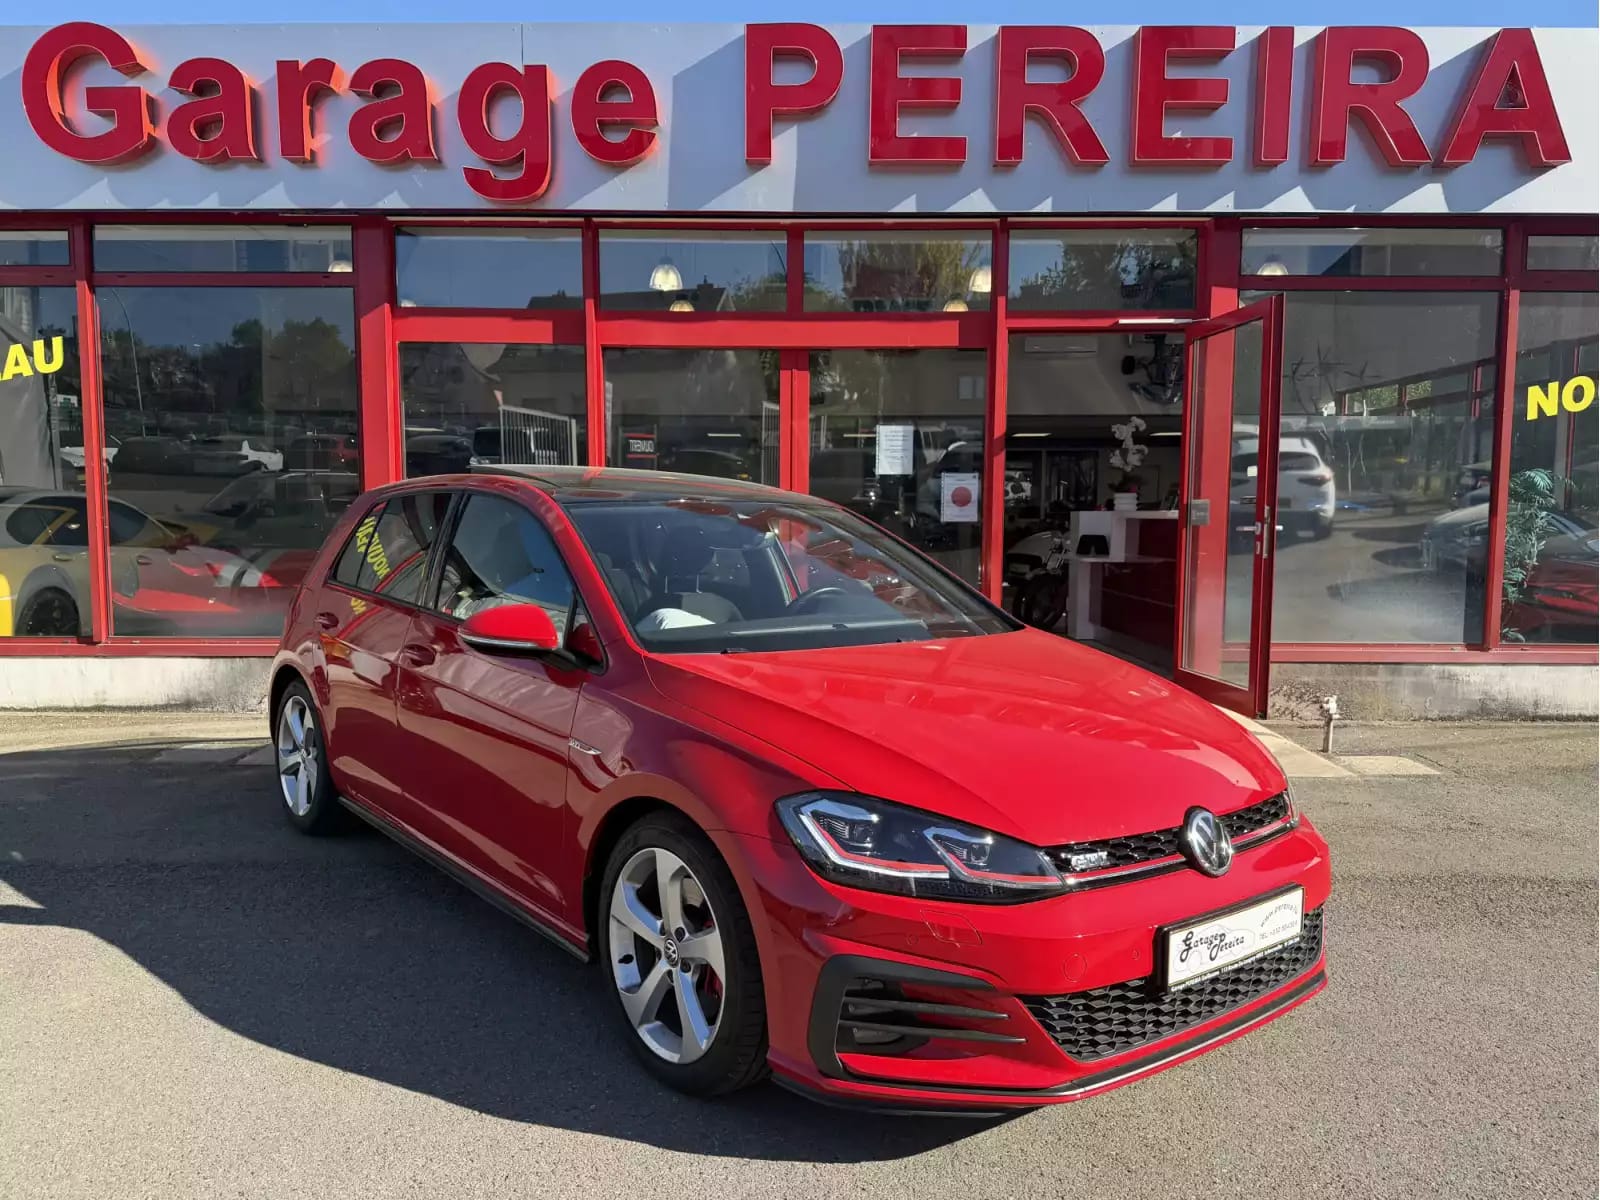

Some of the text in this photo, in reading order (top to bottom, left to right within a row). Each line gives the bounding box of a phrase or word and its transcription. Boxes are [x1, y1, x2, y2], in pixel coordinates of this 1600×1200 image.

[21, 21, 1571, 202] Garage PEREIRA
[0, 336, 64, 381] AU
[1526, 375, 1596, 421] NO
[1180, 931, 1219, 962] Garage
[1209, 932, 1245, 961] Pereira
